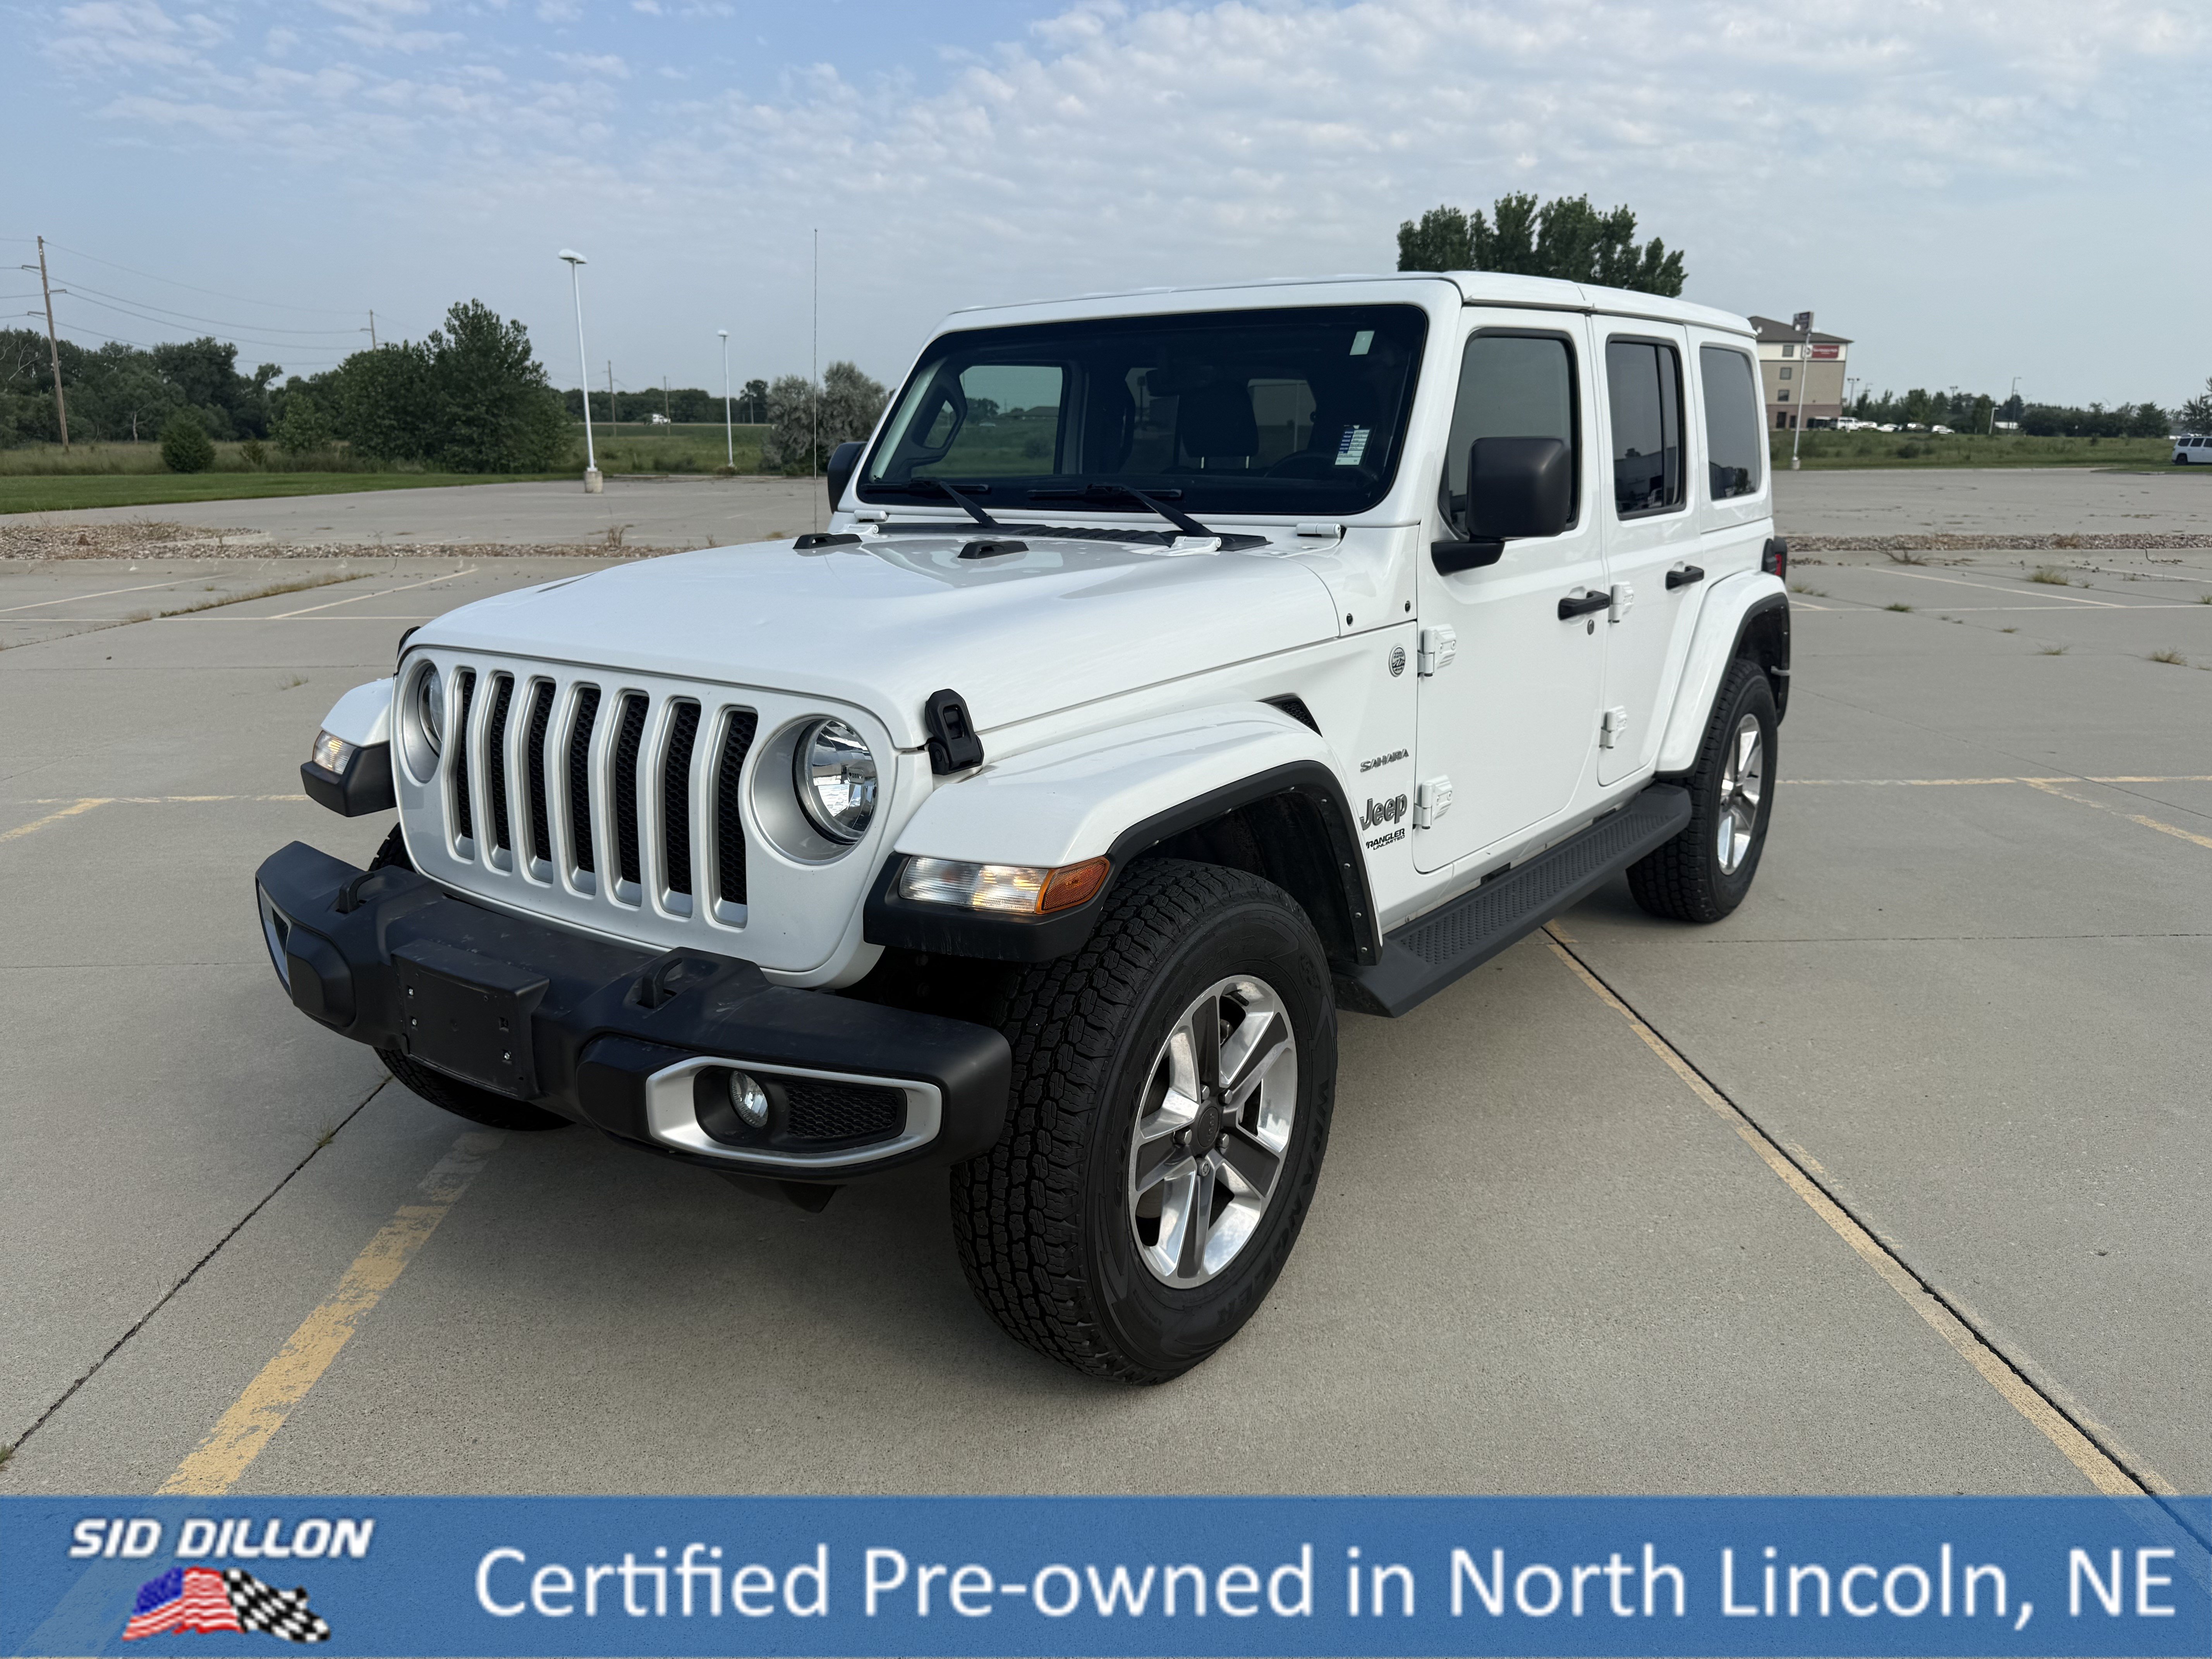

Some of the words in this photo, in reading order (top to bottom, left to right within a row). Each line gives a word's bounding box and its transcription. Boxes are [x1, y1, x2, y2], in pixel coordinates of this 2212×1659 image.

[1360, 748, 1409, 773] SAHARA
[1359, 794, 1407, 831] Jeep
[1373, 835, 1405, 850] UNLIMITED
